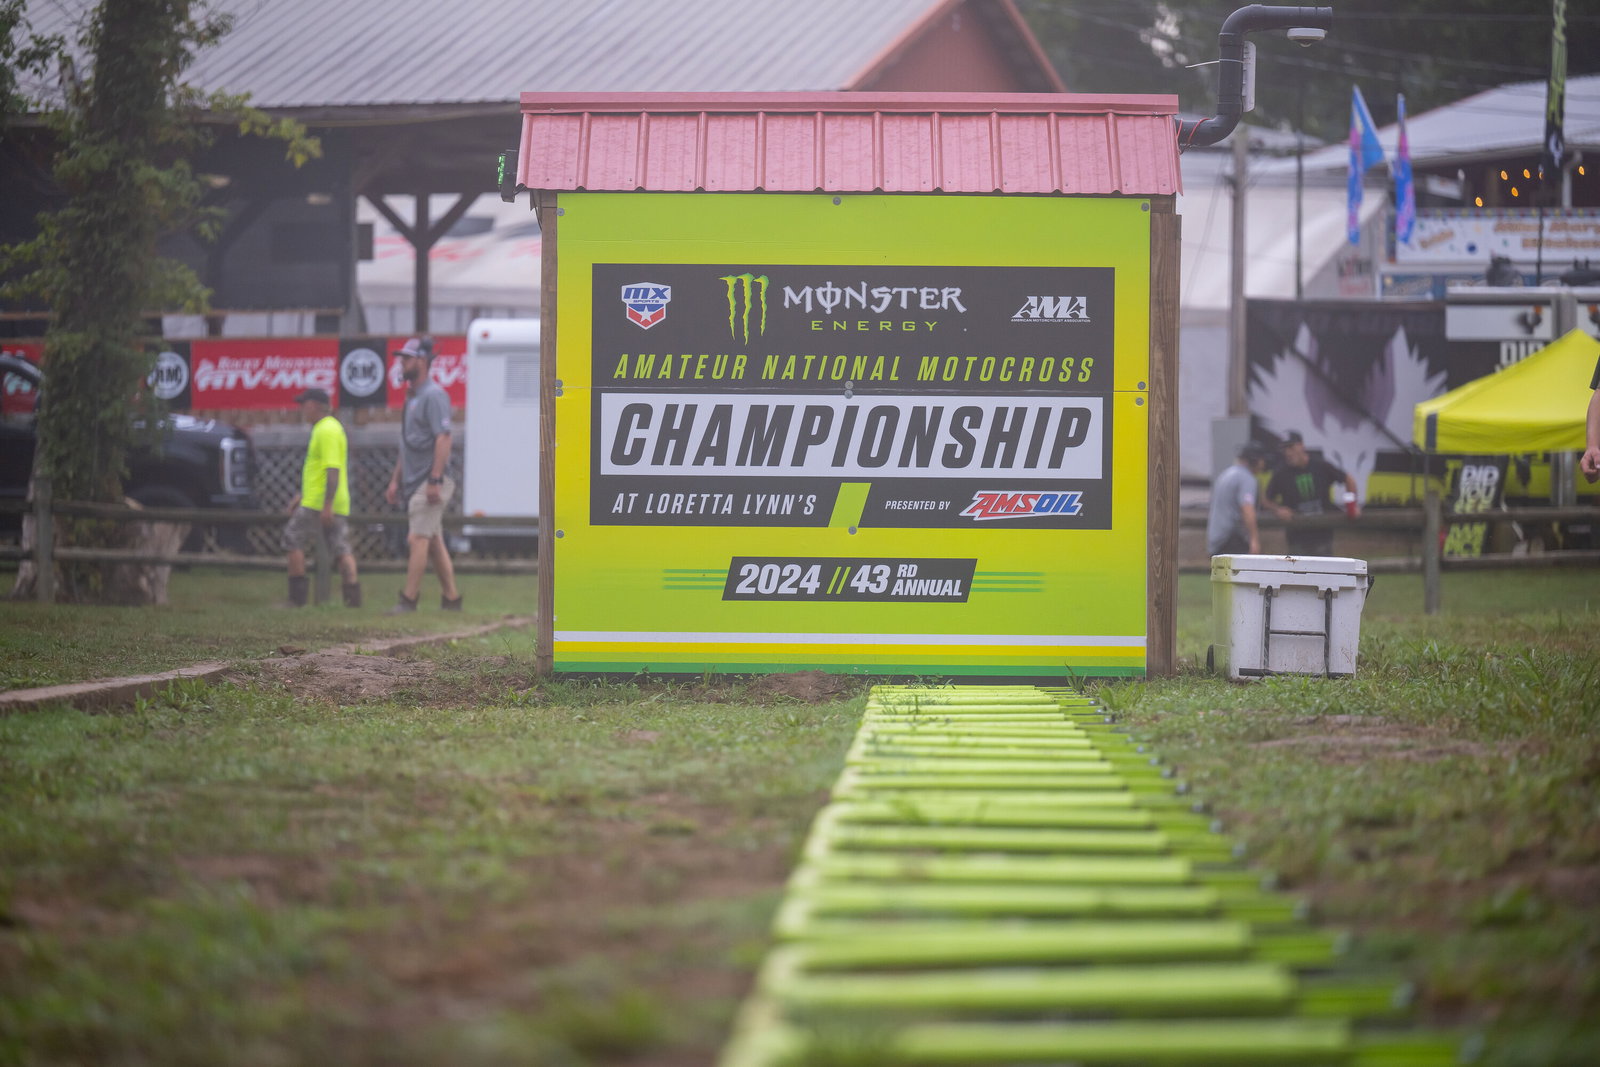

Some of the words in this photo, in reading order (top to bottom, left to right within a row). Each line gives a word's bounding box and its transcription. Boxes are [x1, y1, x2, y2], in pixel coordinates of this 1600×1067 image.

[624, 287, 670, 300] MX
[782, 281, 968, 315] MONSTER
[1011, 295, 1091, 319] AMA
[811, 320, 938, 332] ENERGY
[613, 353, 749, 381] AMATEUR
[761, 354, 901, 382] NATIONAL
[916, 355, 1095, 383] MOTOCROSS
[610, 402, 1093, 470] CHAMPIONSHIP
[611, 492, 638, 514] AT
[645, 492, 733, 515] LORETTA
[742, 494, 818, 516] LYNN'S
[884, 500, 938, 511] PRESENTED
[938, 500, 951, 511] BY
[963, 491, 1083, 519] AMSOIL
[735, 563, 822, 595] 2024
[897, 563, 918, 578] RD
[890, 578, 963, 597] ANNUAL
